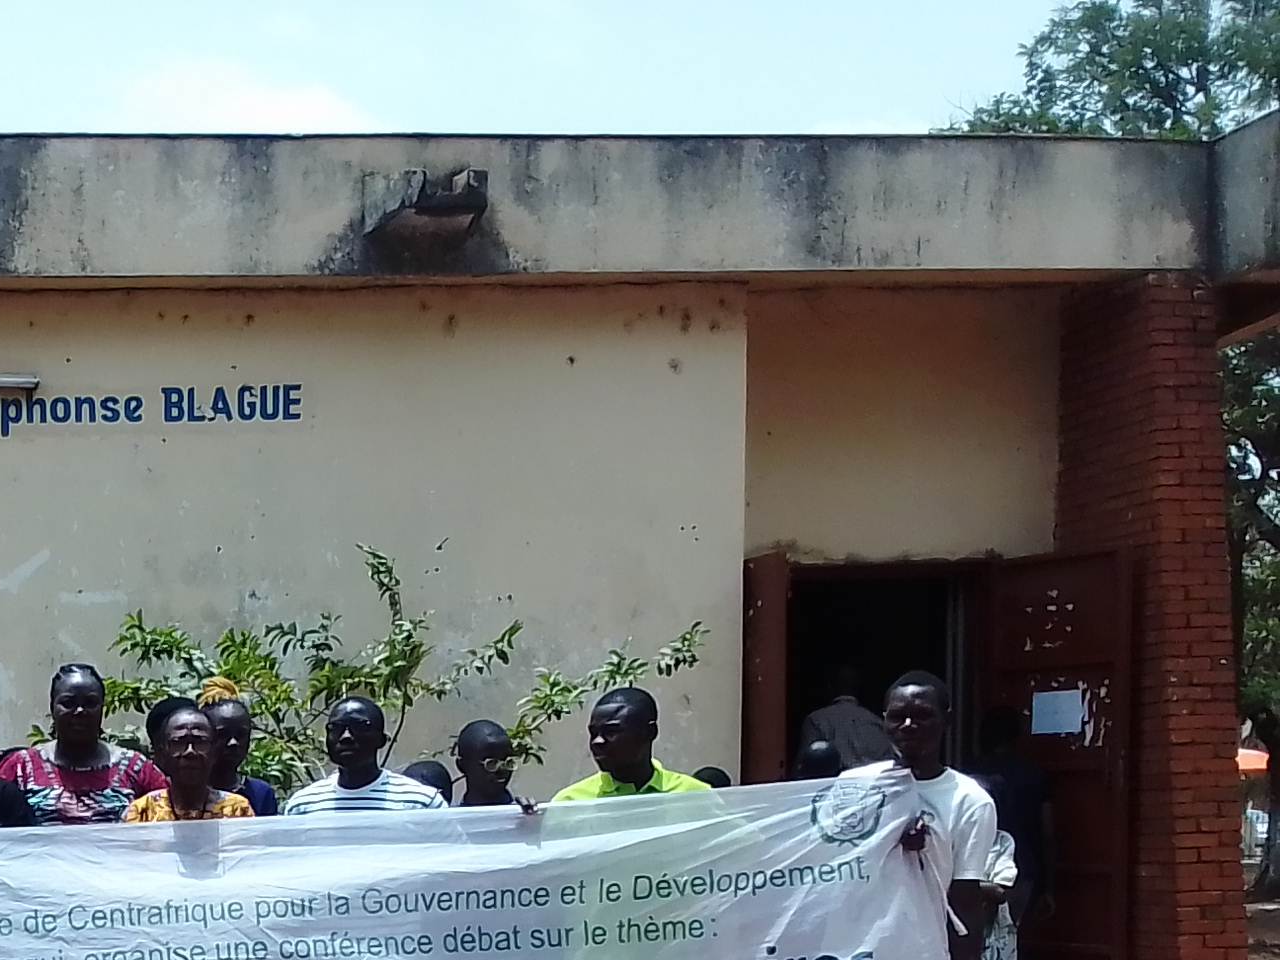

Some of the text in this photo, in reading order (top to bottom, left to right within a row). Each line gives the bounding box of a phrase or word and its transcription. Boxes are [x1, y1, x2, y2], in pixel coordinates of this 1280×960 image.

[161, 383, 303, 422] BLAGUE
[22, 908, 58, 934] de
[68, 897, 245, 930] Centrafrique
[255, 900, 315, 926] pour
[327, 891, 351, 916] la
[361, 887, 551, 915] Gouvernance
[560, 879, 587, 905] et
[598, 877, 622, 903] le
[633, 855, 871, 900] Développement,
[278, 930, 434, 960] conférence
[442, 924, 523, 954] débat
[529, 927, 574, 949] sur
[583, 919, 608, 946] le
